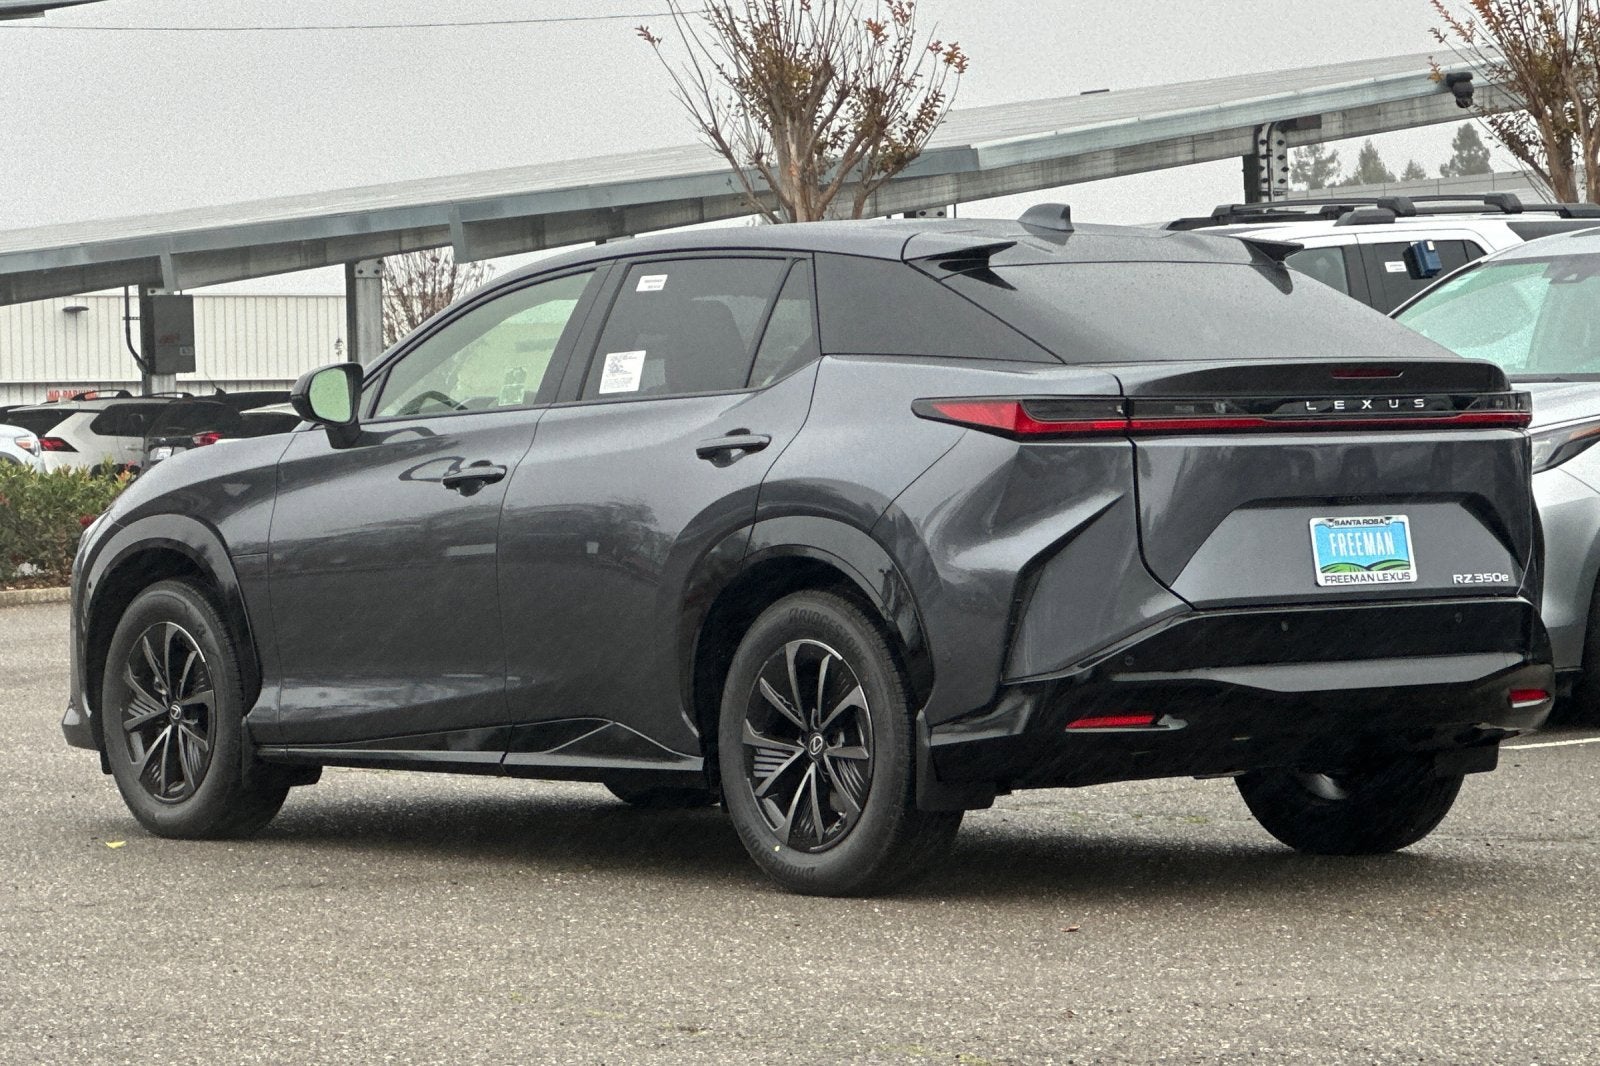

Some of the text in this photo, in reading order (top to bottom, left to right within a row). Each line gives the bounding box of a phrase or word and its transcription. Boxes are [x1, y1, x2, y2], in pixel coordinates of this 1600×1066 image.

[48, 390, 60, 398] NO
[1305, 398, 1425, 410] LEXUS
[1334, 518, 1361, 526] SANTA
[1329, 530, 1395, 557] FREEMAN
[1324, 571, 1411, 584] FREEMAN LEXUS
